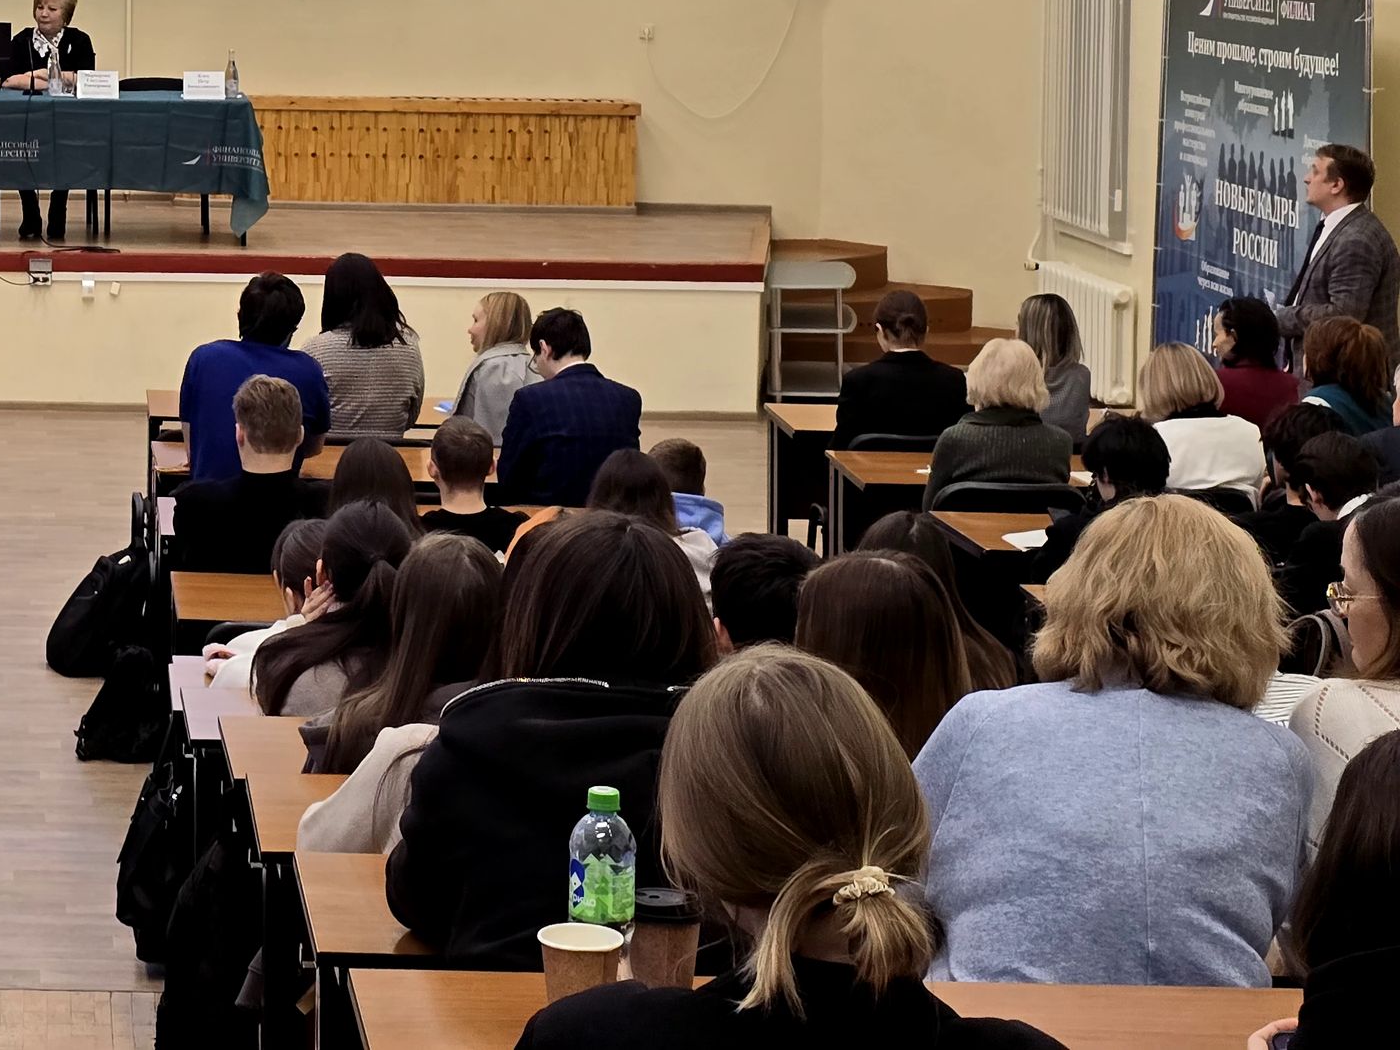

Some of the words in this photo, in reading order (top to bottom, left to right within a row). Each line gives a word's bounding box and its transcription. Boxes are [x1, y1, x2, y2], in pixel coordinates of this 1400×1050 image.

[1280, 0, 1315, 22] ФИЛИАЛ
[1188, 31, 1216, 58] Ценим
[1216, 41, 1257, 68] прошлое,
[1258, 48, 1292, 73] строим
[1293, 47, 1339, 79] будущее!
[1215, 178, 1256, 216] НОВЫЕ
[1257, 191, 1300, 230] КАДРЫ
[1232, 227, 1279, 268] РОССИИ
